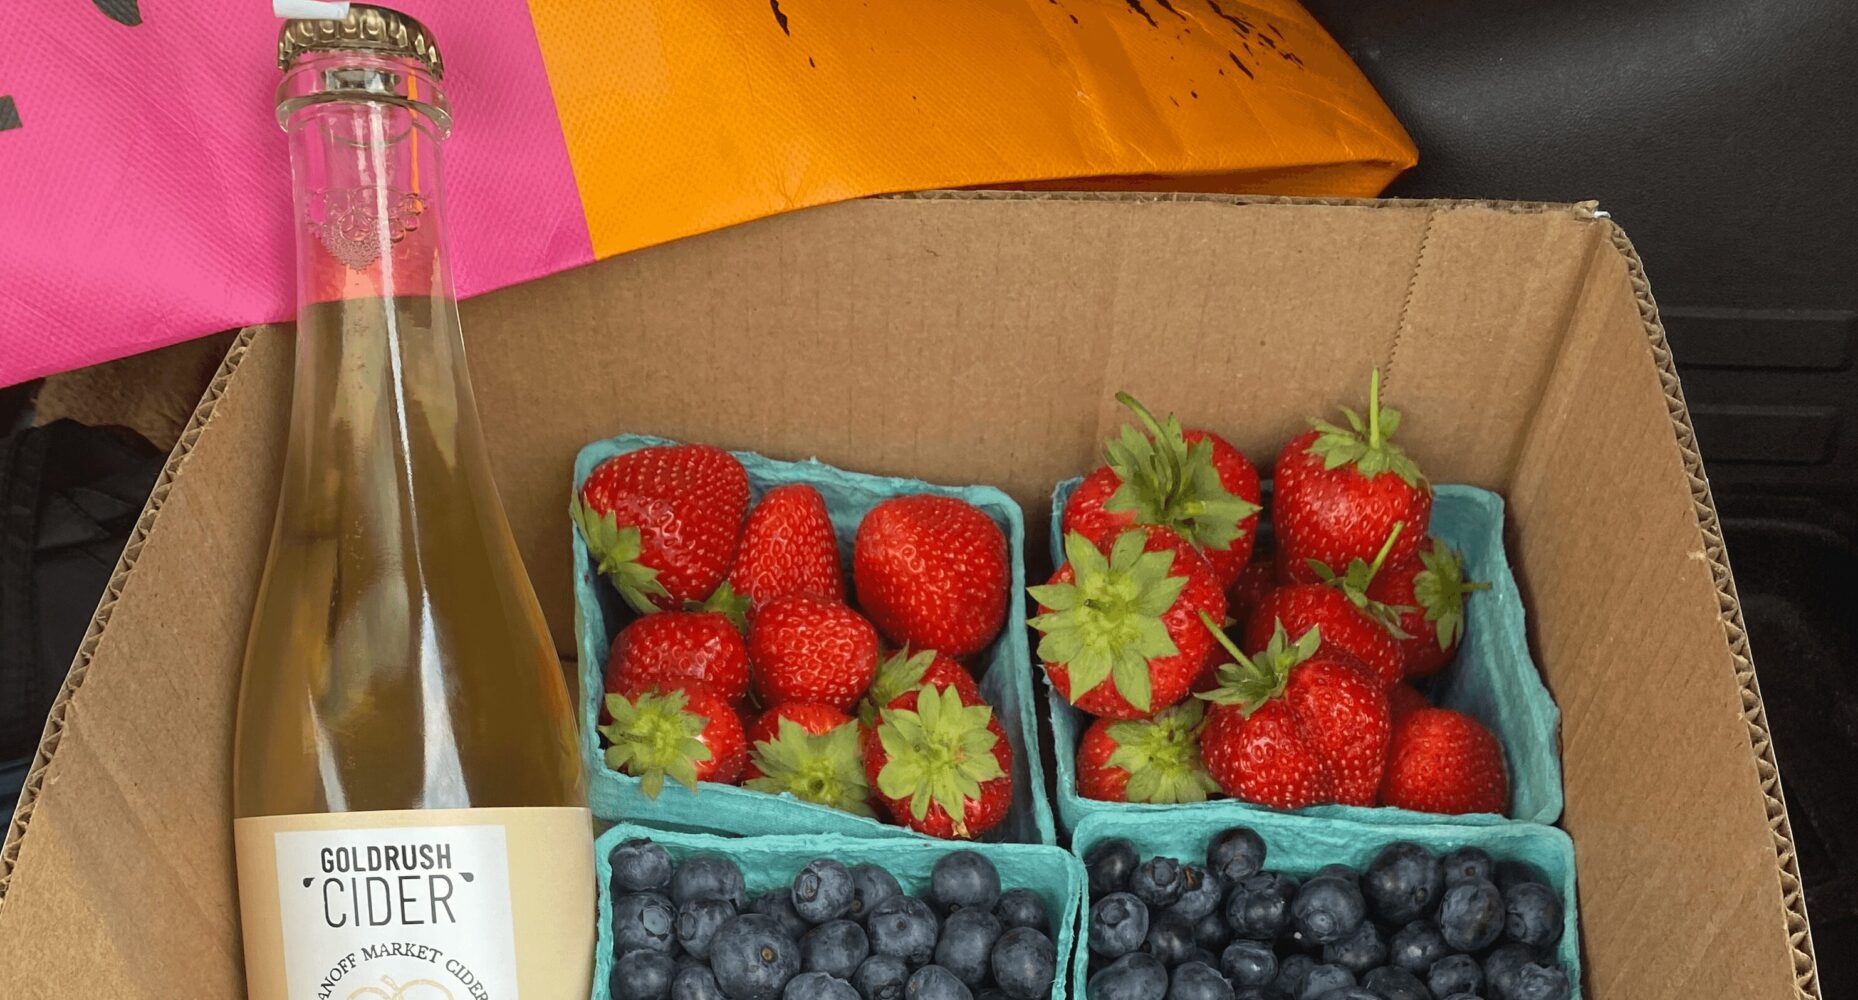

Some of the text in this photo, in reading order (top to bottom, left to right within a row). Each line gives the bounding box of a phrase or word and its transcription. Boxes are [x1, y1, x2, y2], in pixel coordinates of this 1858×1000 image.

[321, 843, 452, 873] GOLDRUSH
[323, 874, 456, 928] CIDER
[361, 942, 443, 964] MARKET
